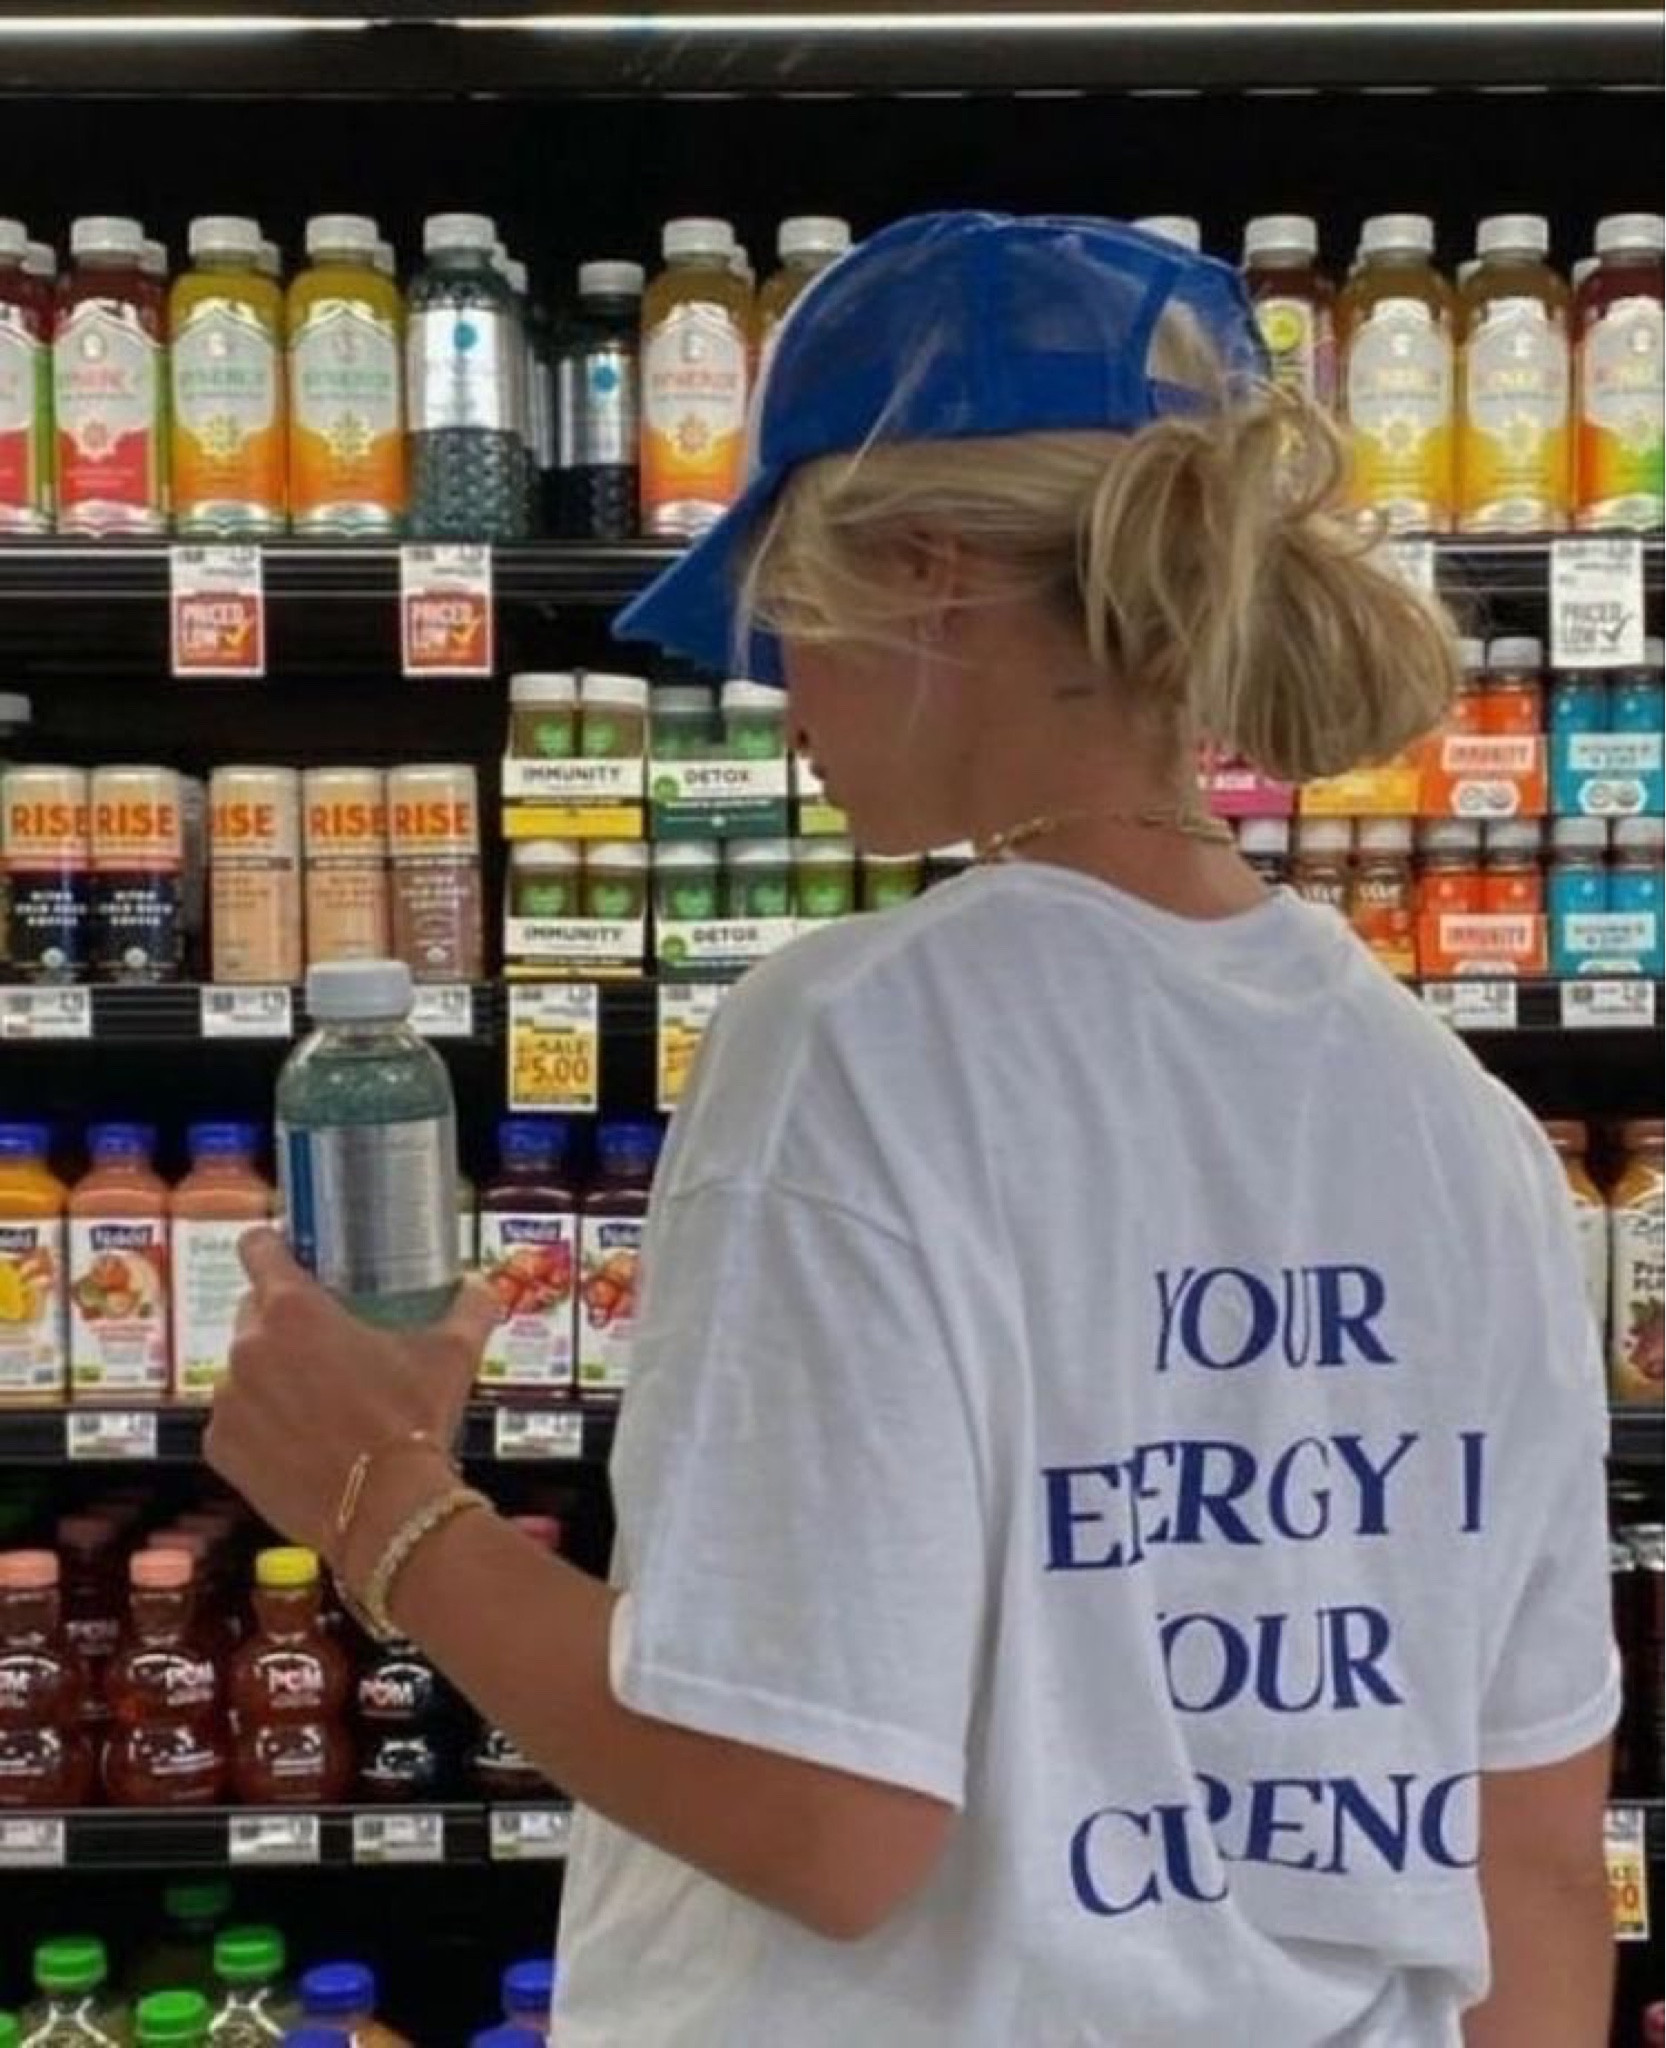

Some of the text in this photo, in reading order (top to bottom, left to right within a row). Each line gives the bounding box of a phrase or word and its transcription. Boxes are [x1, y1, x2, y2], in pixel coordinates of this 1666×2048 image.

[522, 764, 622, 782] IMMUNITY
[684, 768, 750, 785] DETOX
[12, 803, 90, 837] RISE
[97, 803, 175, 838] RISE
[212, 803, 276, 837] ISE
[309, 803, 387, 837] RISE
[394, 802, 466, 837] RISE
[523, 926, 623, 942] IMMUNITY
[1155, 1265, 1396, 1371] YOUR
[1155, 1606, 1405, 1713] OUR
[268, 1664, 324, 1693] POM
[359, 1680, 414, 1706] POM
